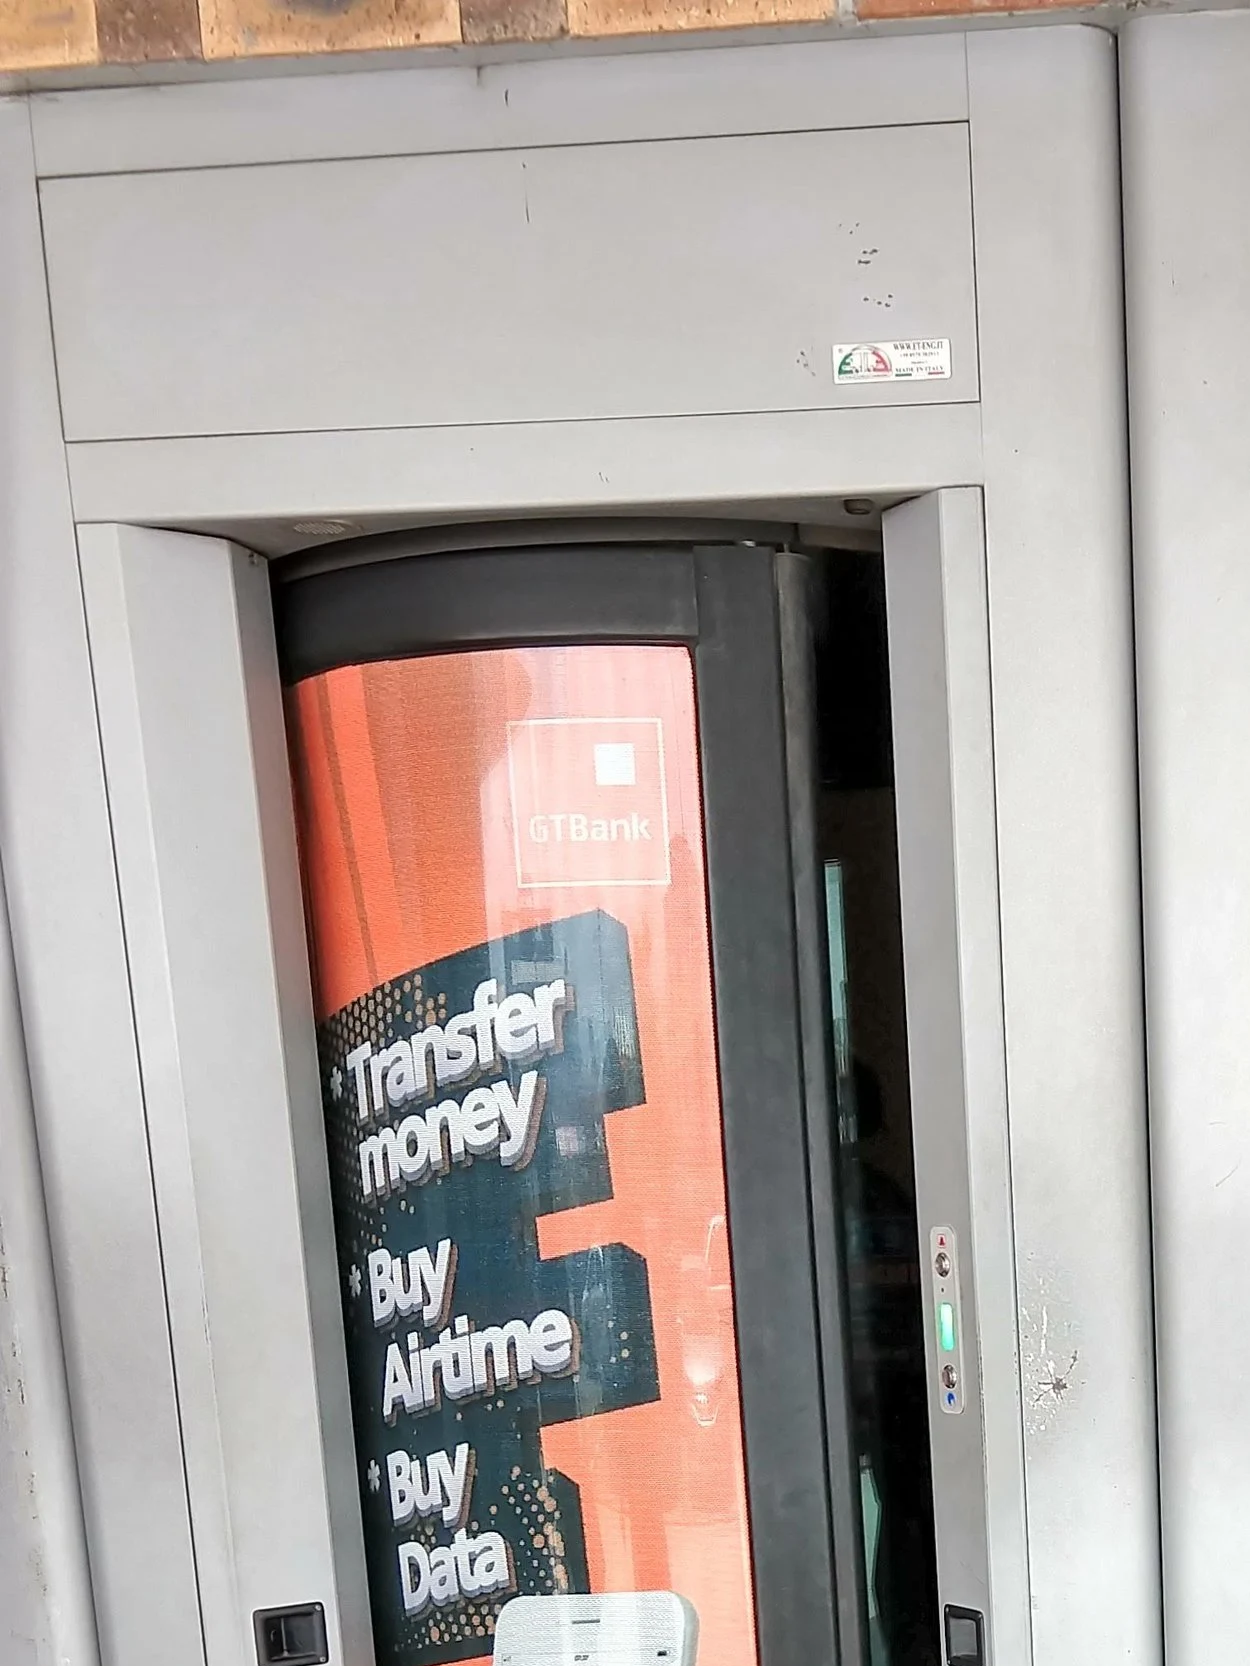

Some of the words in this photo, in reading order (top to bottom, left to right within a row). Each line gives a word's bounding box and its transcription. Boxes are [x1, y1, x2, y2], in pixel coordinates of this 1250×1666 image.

[529, 812, 653, 844] GTBank
[358, 1069, 544, 1204] money
[382, 1308, 576, 1423] Airtime
[397, 1527, 515, 1617] Data
